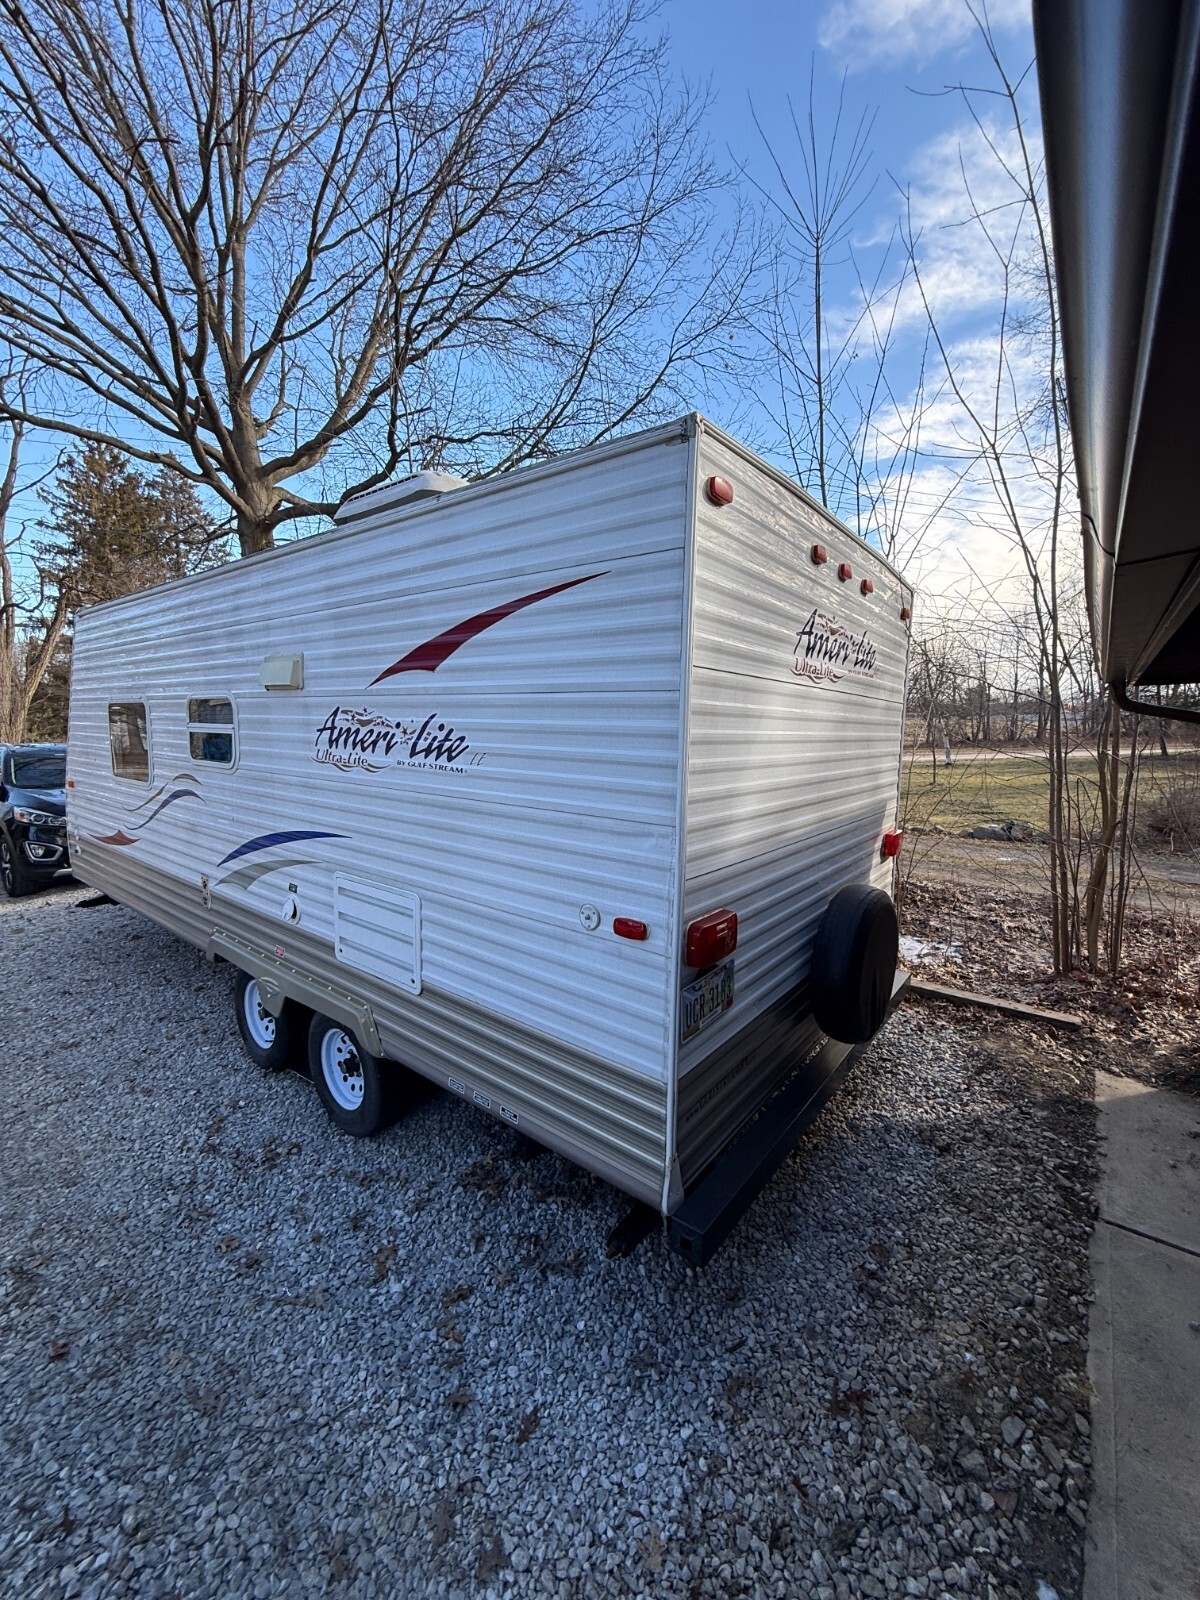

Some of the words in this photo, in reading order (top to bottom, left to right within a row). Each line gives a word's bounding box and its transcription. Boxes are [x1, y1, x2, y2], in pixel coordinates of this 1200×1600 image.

[794, 608, 853, 666] Ameri
[315, 706, 401, 756] Ameri
[409, 713, 470, 763] Lite
[316, 748, 368, 767] Ultra-Lite
[396, 759, 406, 767] BY
[407, 760, 428, 769] GULF
[428, 763, 464, 774] STREAM
[685, 994, 706, 1028] UCR
